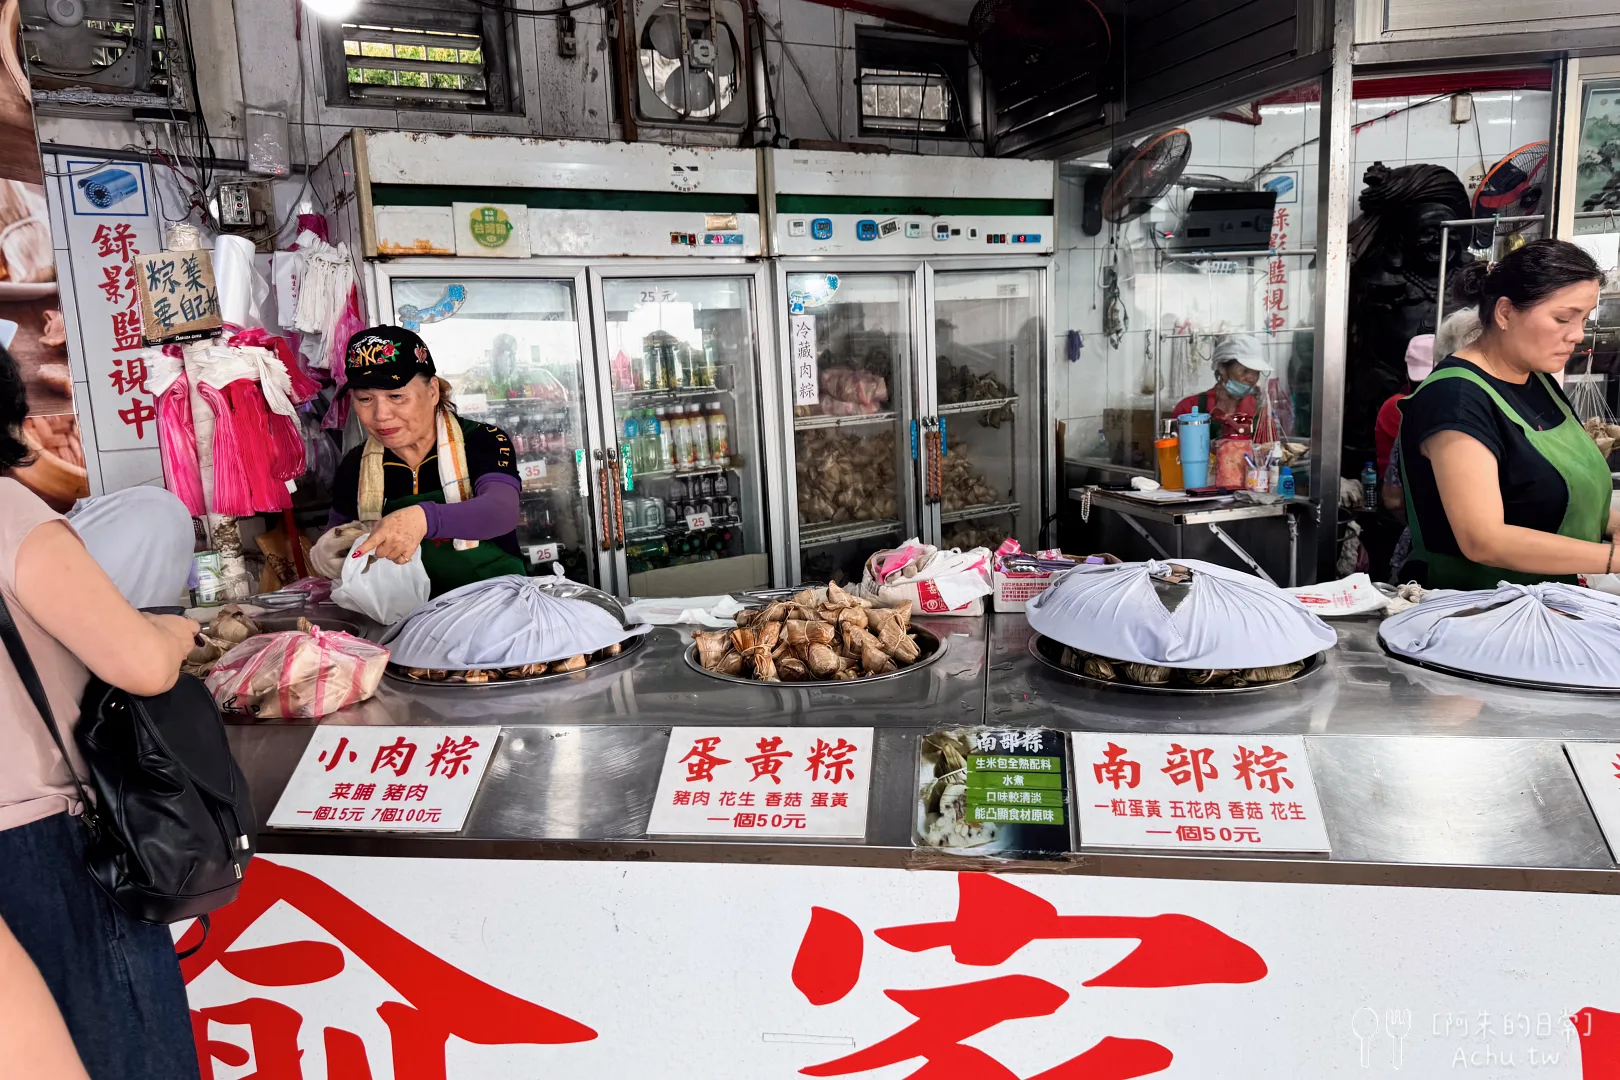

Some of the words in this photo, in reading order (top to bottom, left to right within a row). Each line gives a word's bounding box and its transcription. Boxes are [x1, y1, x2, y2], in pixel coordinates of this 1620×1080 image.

[145, 253, 206, 294] 粽葉
[641, 291, 655, 303] 25
[91, 223, 155, 440] 錄影監視中
[796, 321, 815, 399] 冷藏肉粽
[525, 465, 541, 477] 35
[692, 516, 706, 527] 25
[536, 548, 552, 561] 25
[977, 730, 1044, 753] 南部粽
[318, 735, 480, 779] 小肉粽
[677, 736, 858, 784] 蛋黃粽
[975, 757, 1052, 770] 生米包全熟配料
[1092, 741, 1295, 794] 南部粽
[1002, 774, 1025, 786] 水煮
[328, 782, 376, 801] 菜脯
[382, 783, 428, 801] 豬肉
[672, 790, 711, 806] 豬肉
[718, 791, 755, 807] 花生
[765, 791, 803, 807] 香菇
[810, 791, 849, 808] 蛋黃
[986, 791, 1042, 804] 口味較清淡
[296, 806, 365, 822] 一個15元
[371, 807, 441, 823] 7個100元
[974, 807, 1054, 822] 能凸顯食材原味
[1094, 799, 1162, 818] 一粒蛋黃
[1170, 800, 1221, 819] 五花肉
[1228, 801, 1264, 820] 香菇
[1270, 802, 1306, 820] 花生
[707, 812, 807, 829] 一個50元
[1145, 825, 1262, 843] 一個50元
